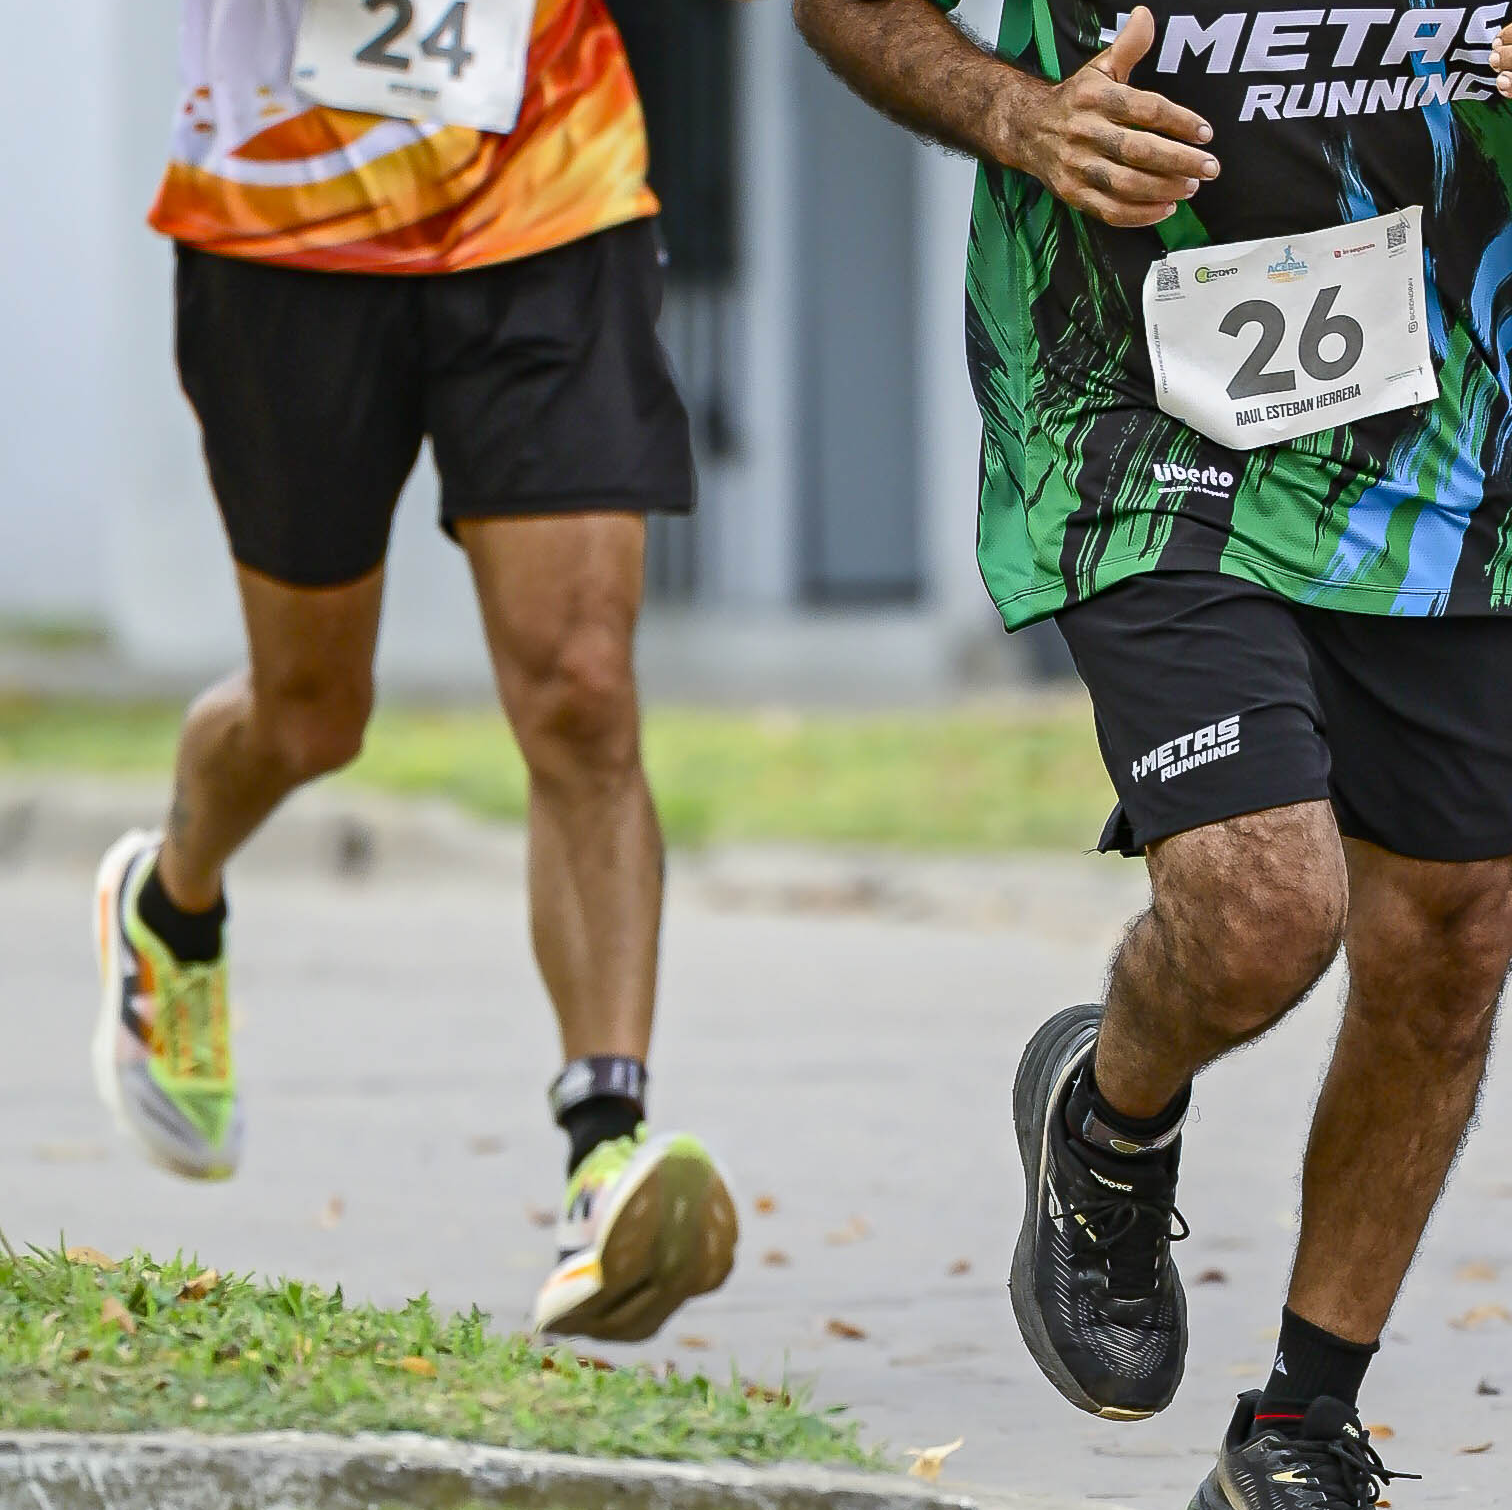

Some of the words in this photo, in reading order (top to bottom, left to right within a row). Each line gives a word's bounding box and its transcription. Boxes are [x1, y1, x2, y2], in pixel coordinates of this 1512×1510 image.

[1239, 71, 1500, 122] RUNNING
[1218, 284, 1365, 401] 26
[1235, 407, 1265, 427] RAUL
[1265, 397, 1314, 421] ESTEBAN
[1315, 383, 1362, 409] HERRERA
[1152, 463, 1234, 488] liberto
[1160, 739, 1241, 783] RUNNING
